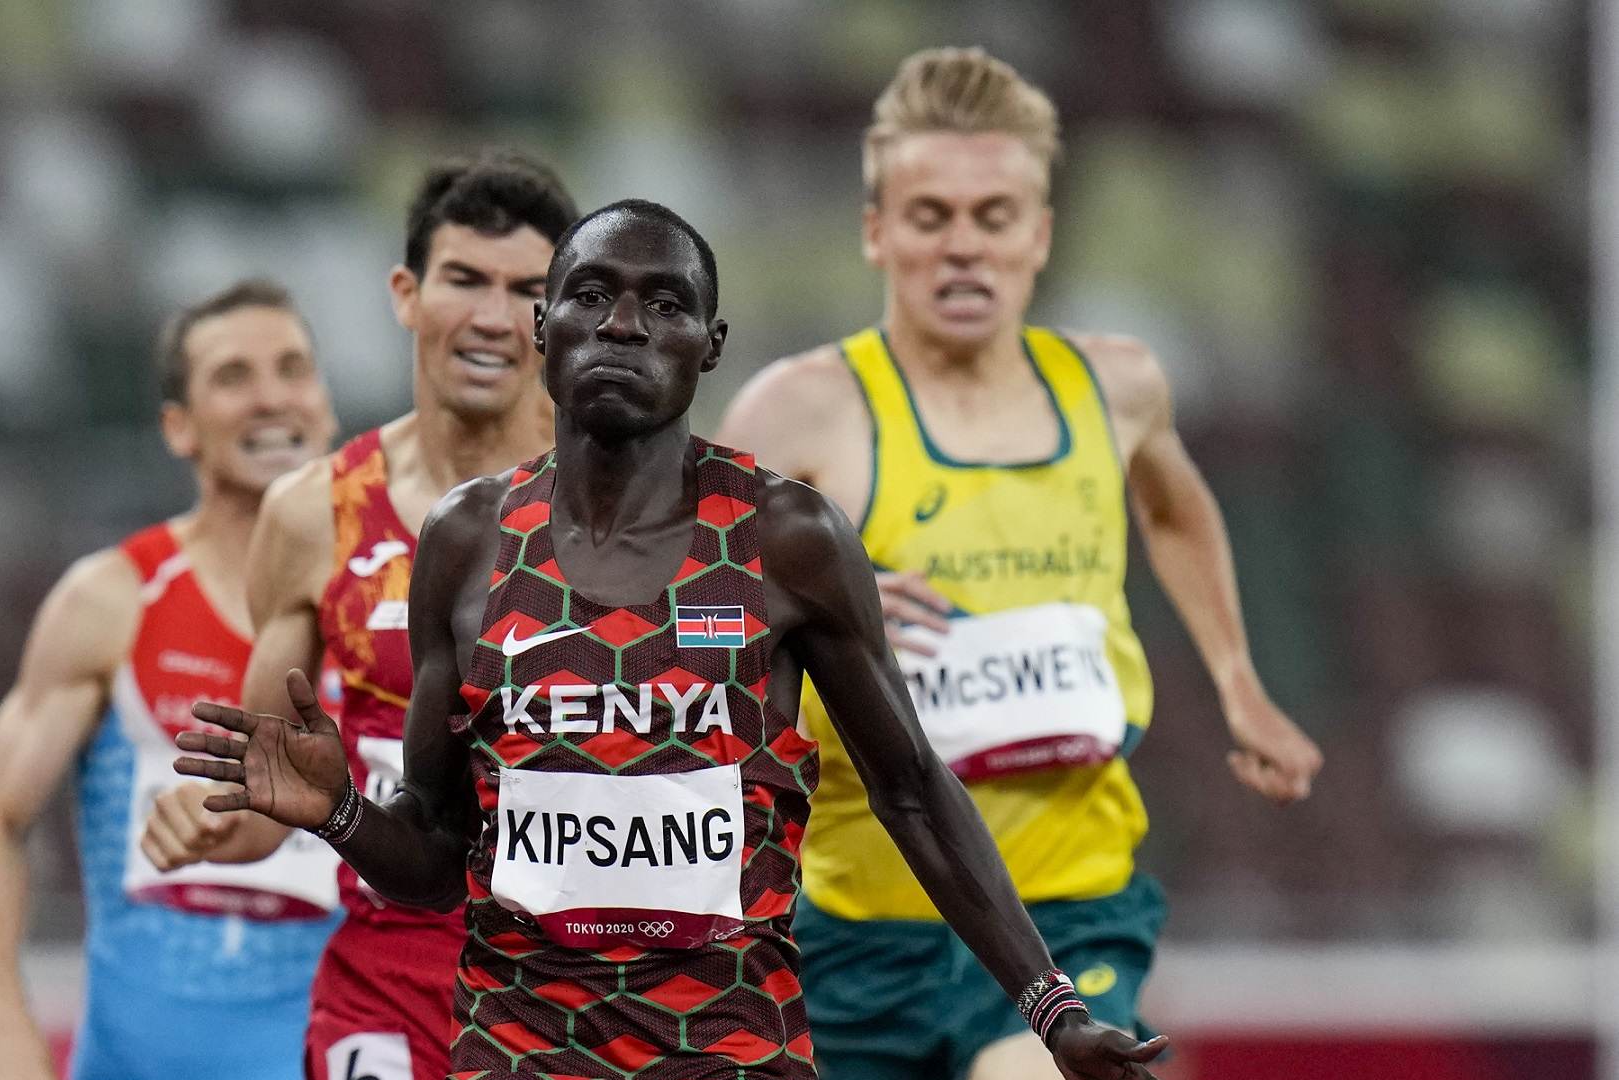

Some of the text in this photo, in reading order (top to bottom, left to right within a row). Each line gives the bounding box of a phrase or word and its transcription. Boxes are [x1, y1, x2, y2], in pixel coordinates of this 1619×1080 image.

[500, 682, 734, 735] KENYA
[506, 807, 735, 868] KIPSANG
[565, 922, 635, 934] TOKYO 2020
